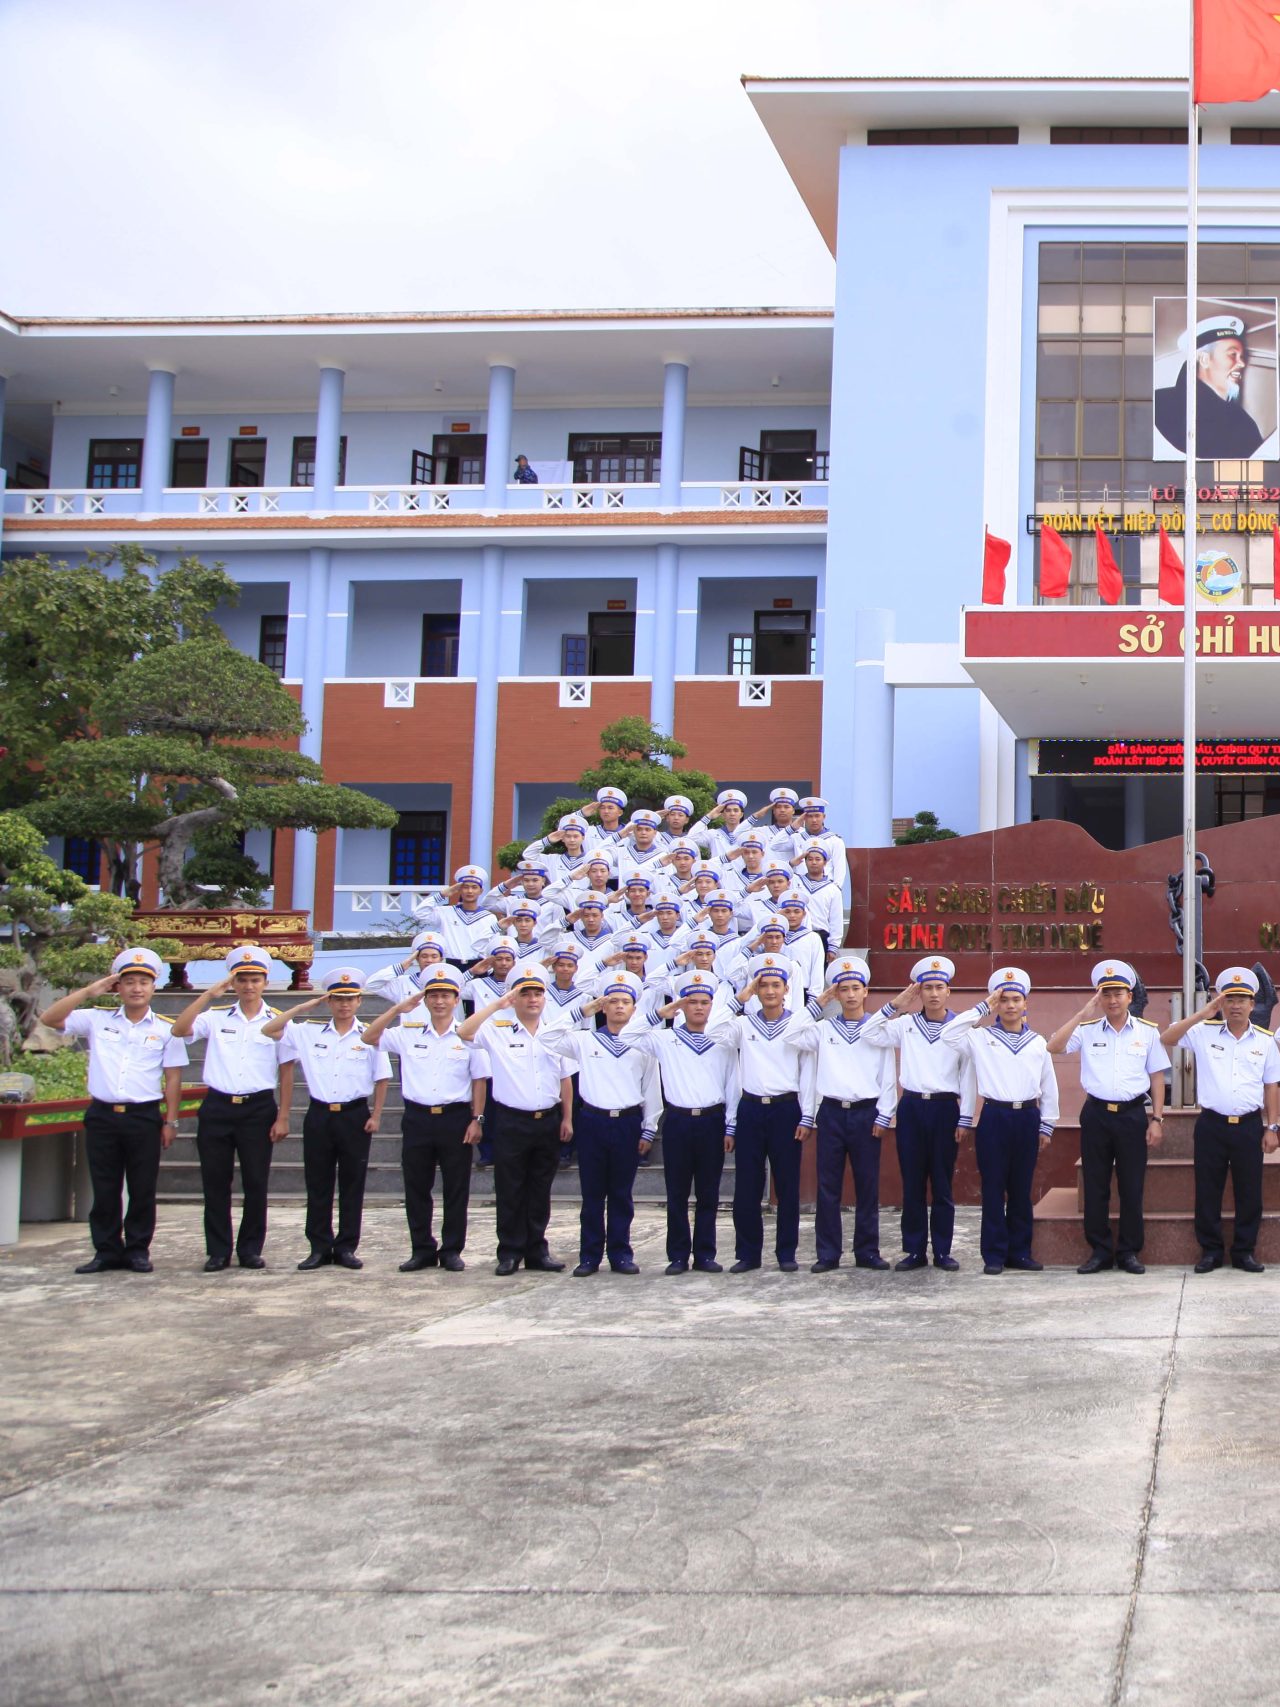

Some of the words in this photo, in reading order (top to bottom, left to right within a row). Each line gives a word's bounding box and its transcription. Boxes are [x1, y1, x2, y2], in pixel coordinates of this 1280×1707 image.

[1197, 484, 1239, 501] OÀN
[1249, 487, 1280, 501] 162
[1043, 511, 1082, 531] ĐOÀN
[1087, 506, 1118, 535] KẾT,
[1124, 510, 1156, 535] HIỆP
[1118, 614, 1164, 654] SỞ
[1195, 742, 1214, 756] ẤU,
[1248, 744, 1270, 756] QUY
[1169, 754, 1201, 766] ĐỒ,
